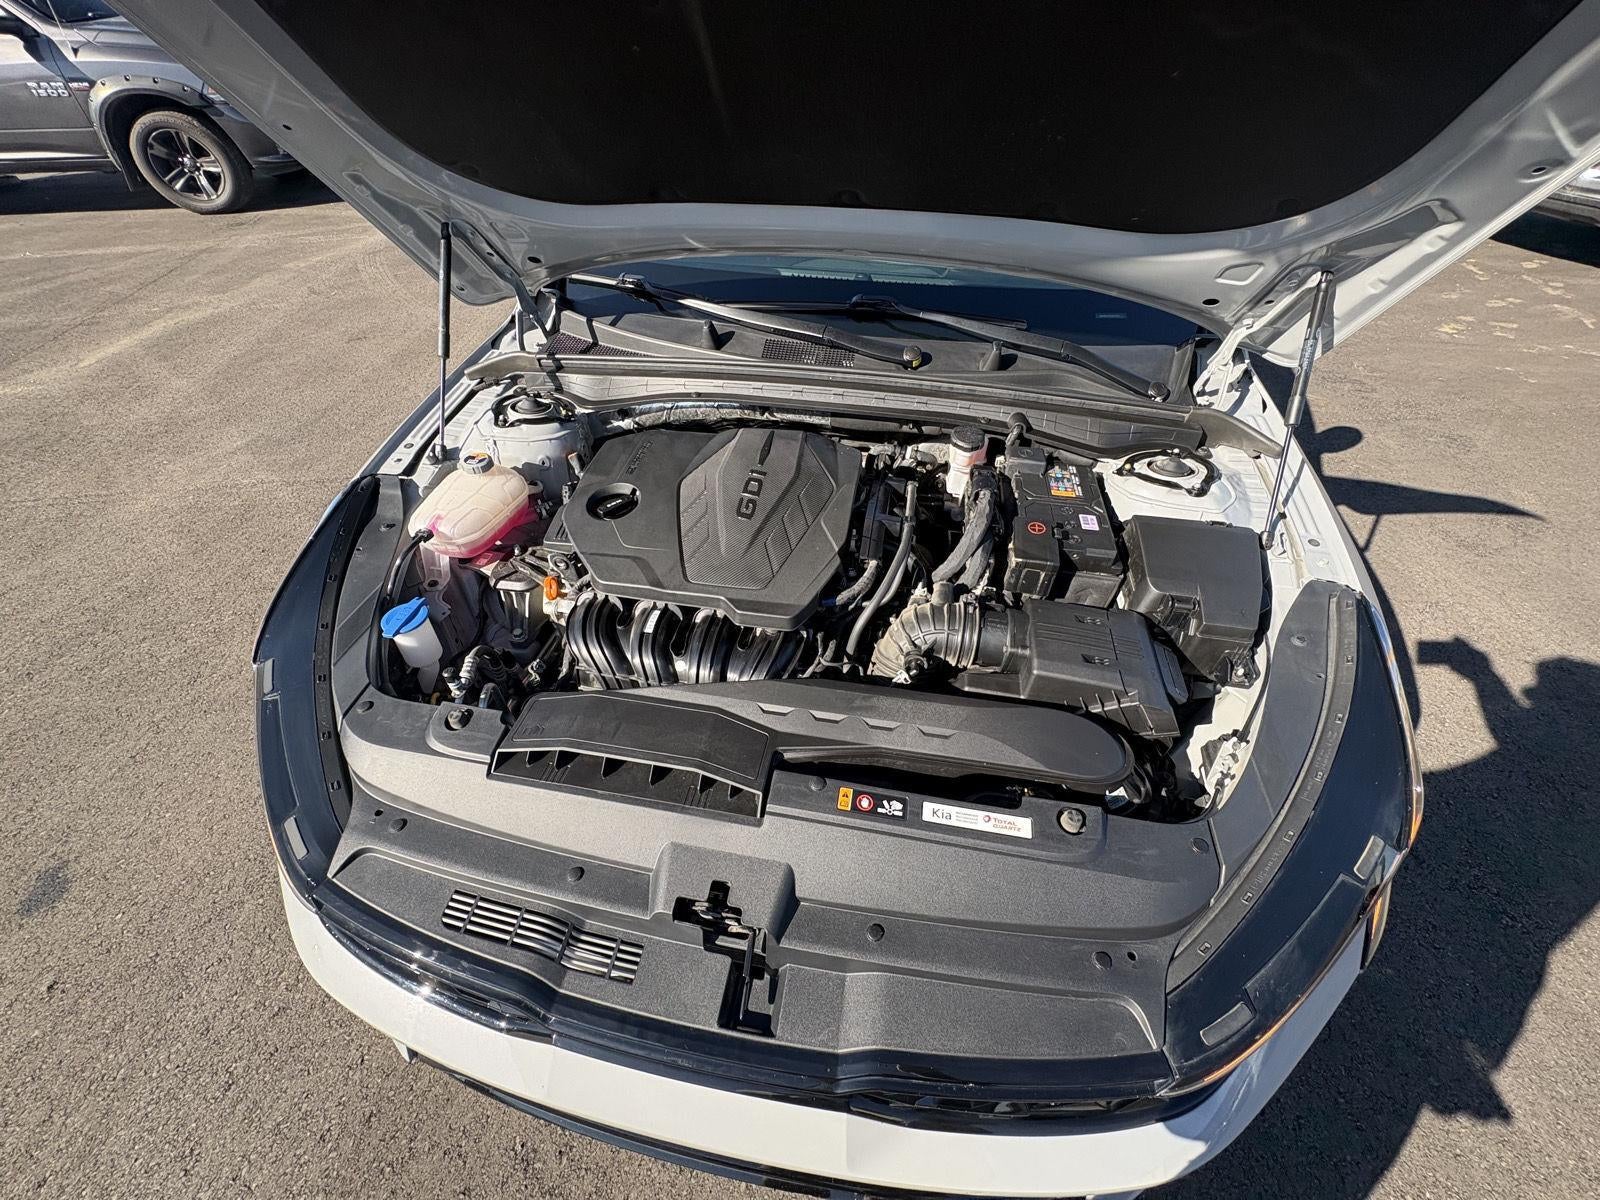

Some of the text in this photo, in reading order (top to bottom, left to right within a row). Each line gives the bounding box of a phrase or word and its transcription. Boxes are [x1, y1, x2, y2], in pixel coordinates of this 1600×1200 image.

[26, 82, 66, 90] RAM
[31, 89, 70, 97] 1500
[736, 469, 767, 520] GDI
[932, 808, 952, 820] Kia
[993, 817, 1018, 827] TOTAL
